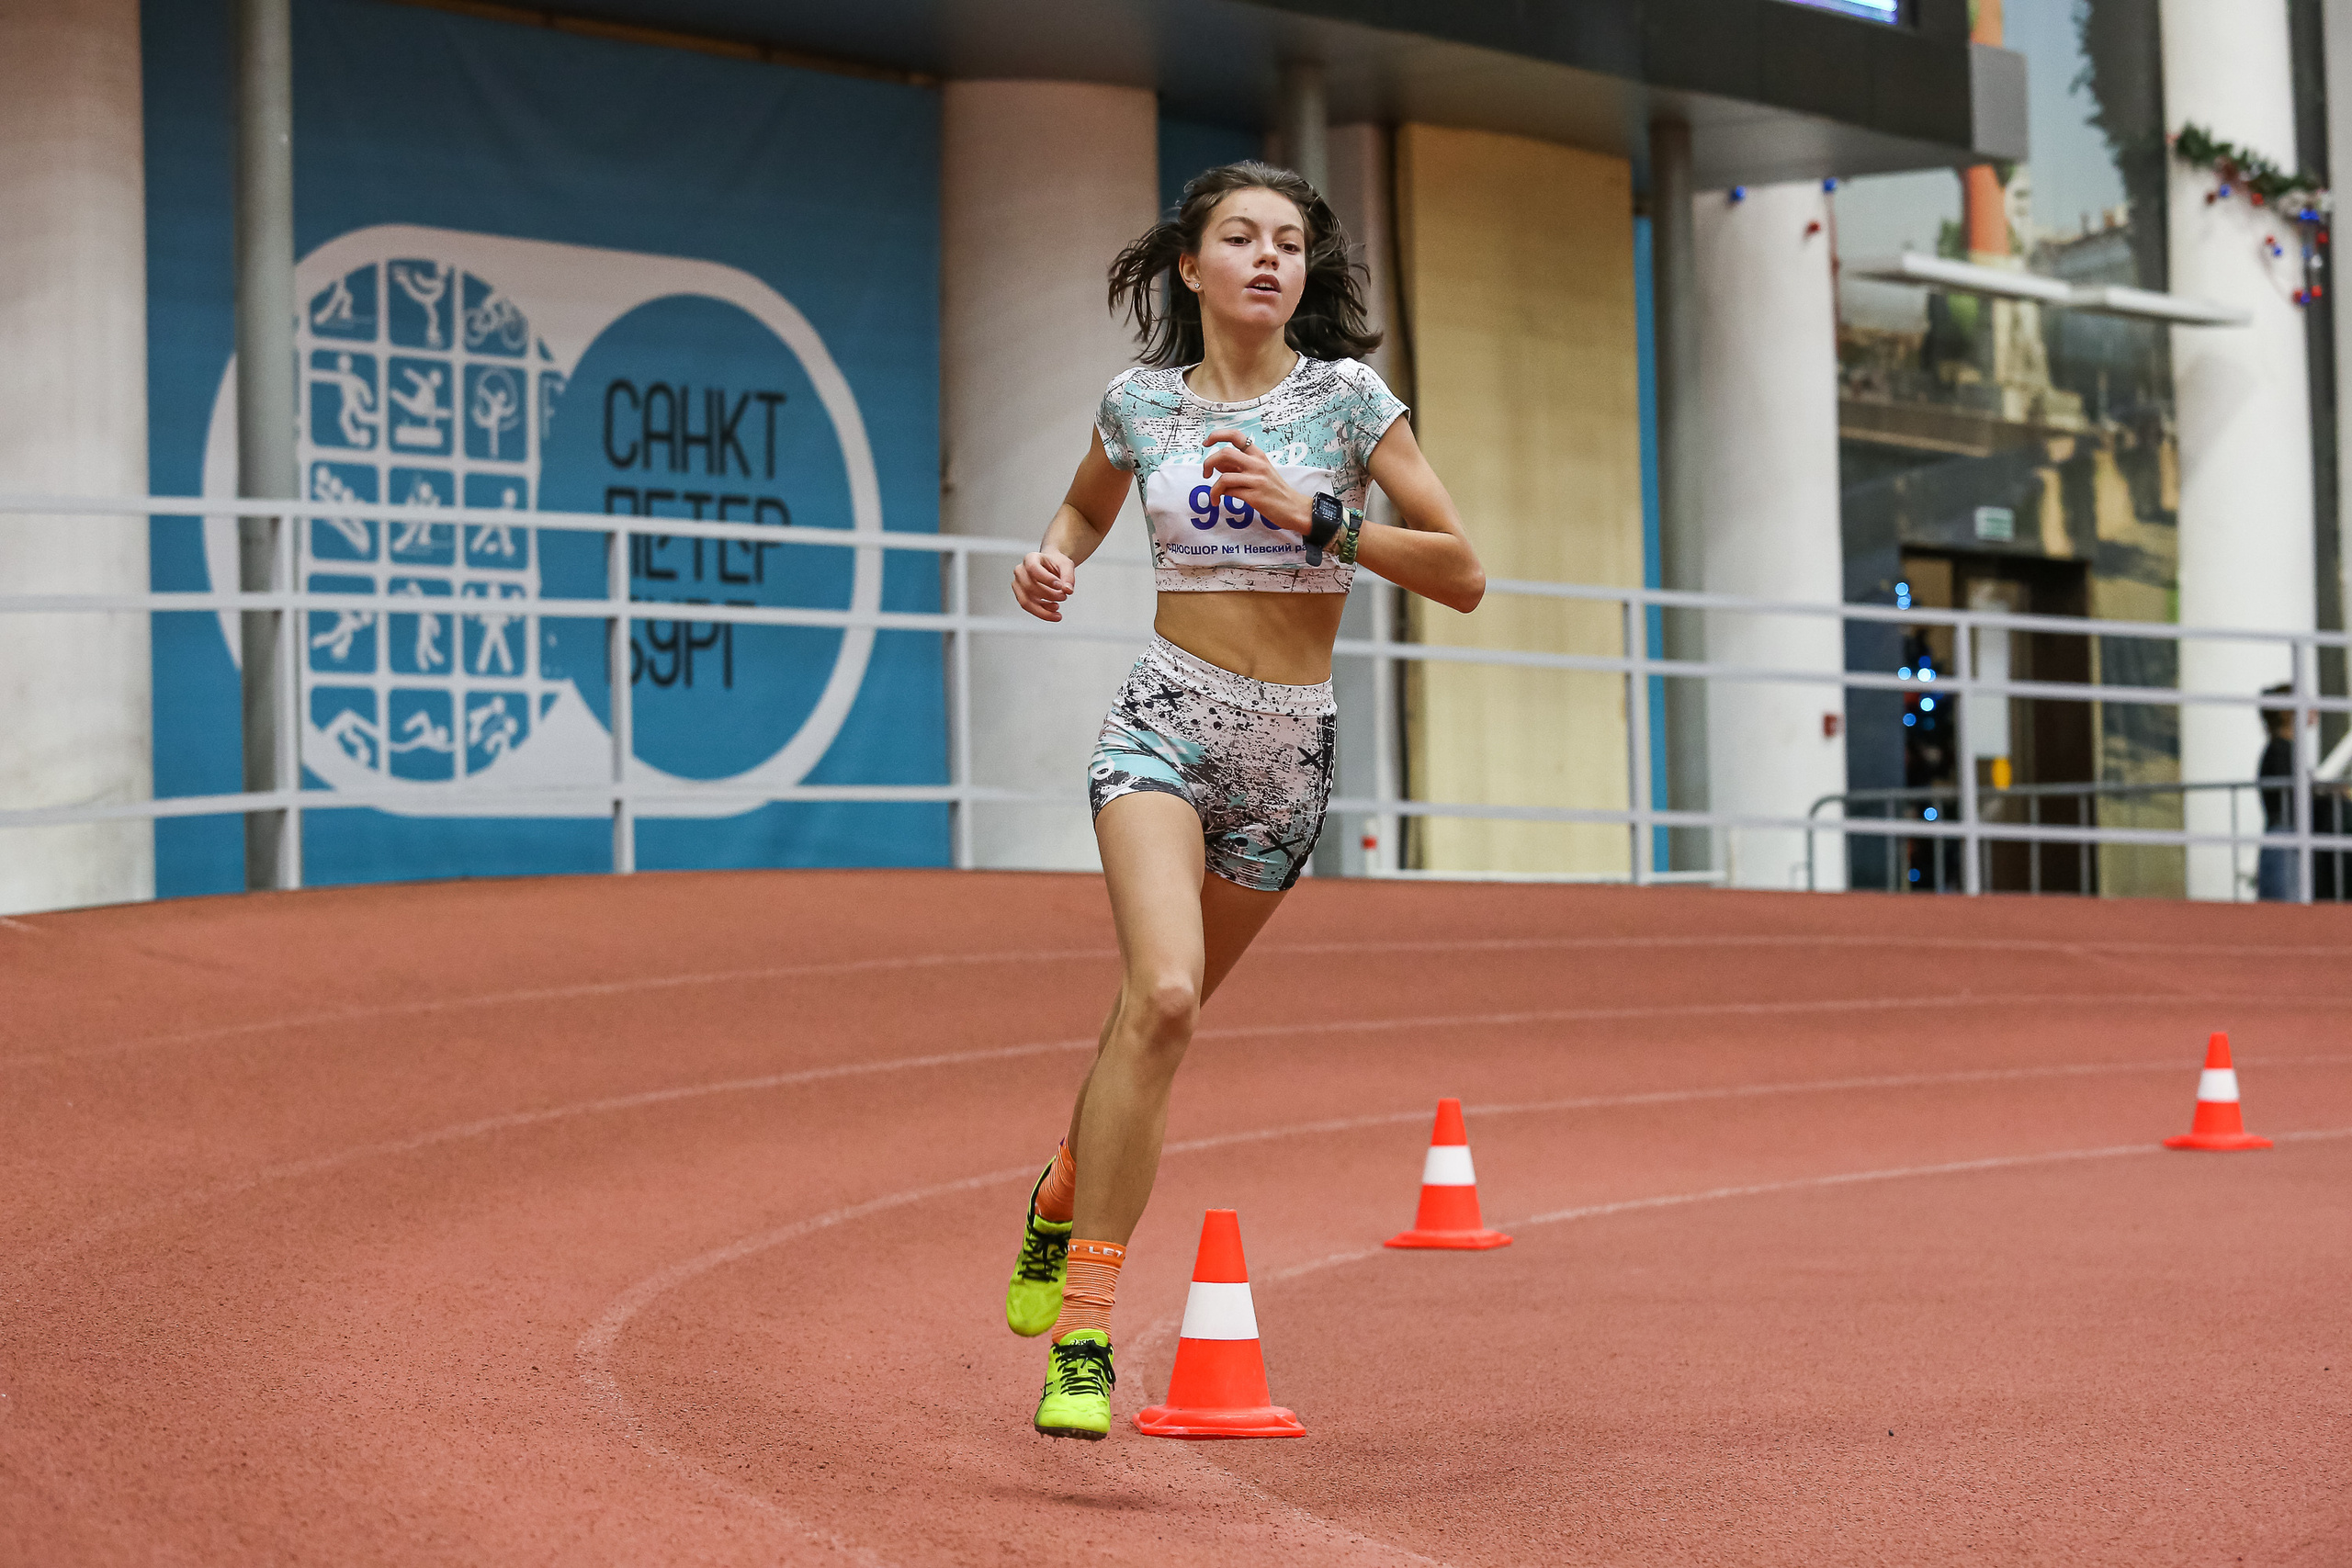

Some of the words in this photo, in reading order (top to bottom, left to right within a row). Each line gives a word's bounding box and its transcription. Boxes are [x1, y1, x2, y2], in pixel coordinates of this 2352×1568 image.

[604, 378, 786, 479] САНКТ
[605, 487, 791, 584] ПЕТЕР
[1189, 485, 1283, 530] 99
[1166, 543, 1218, 556] СДЮСШОР
[1221, 544, 1240, 555] №1
[1244, 542, 1292, 555] Невский
